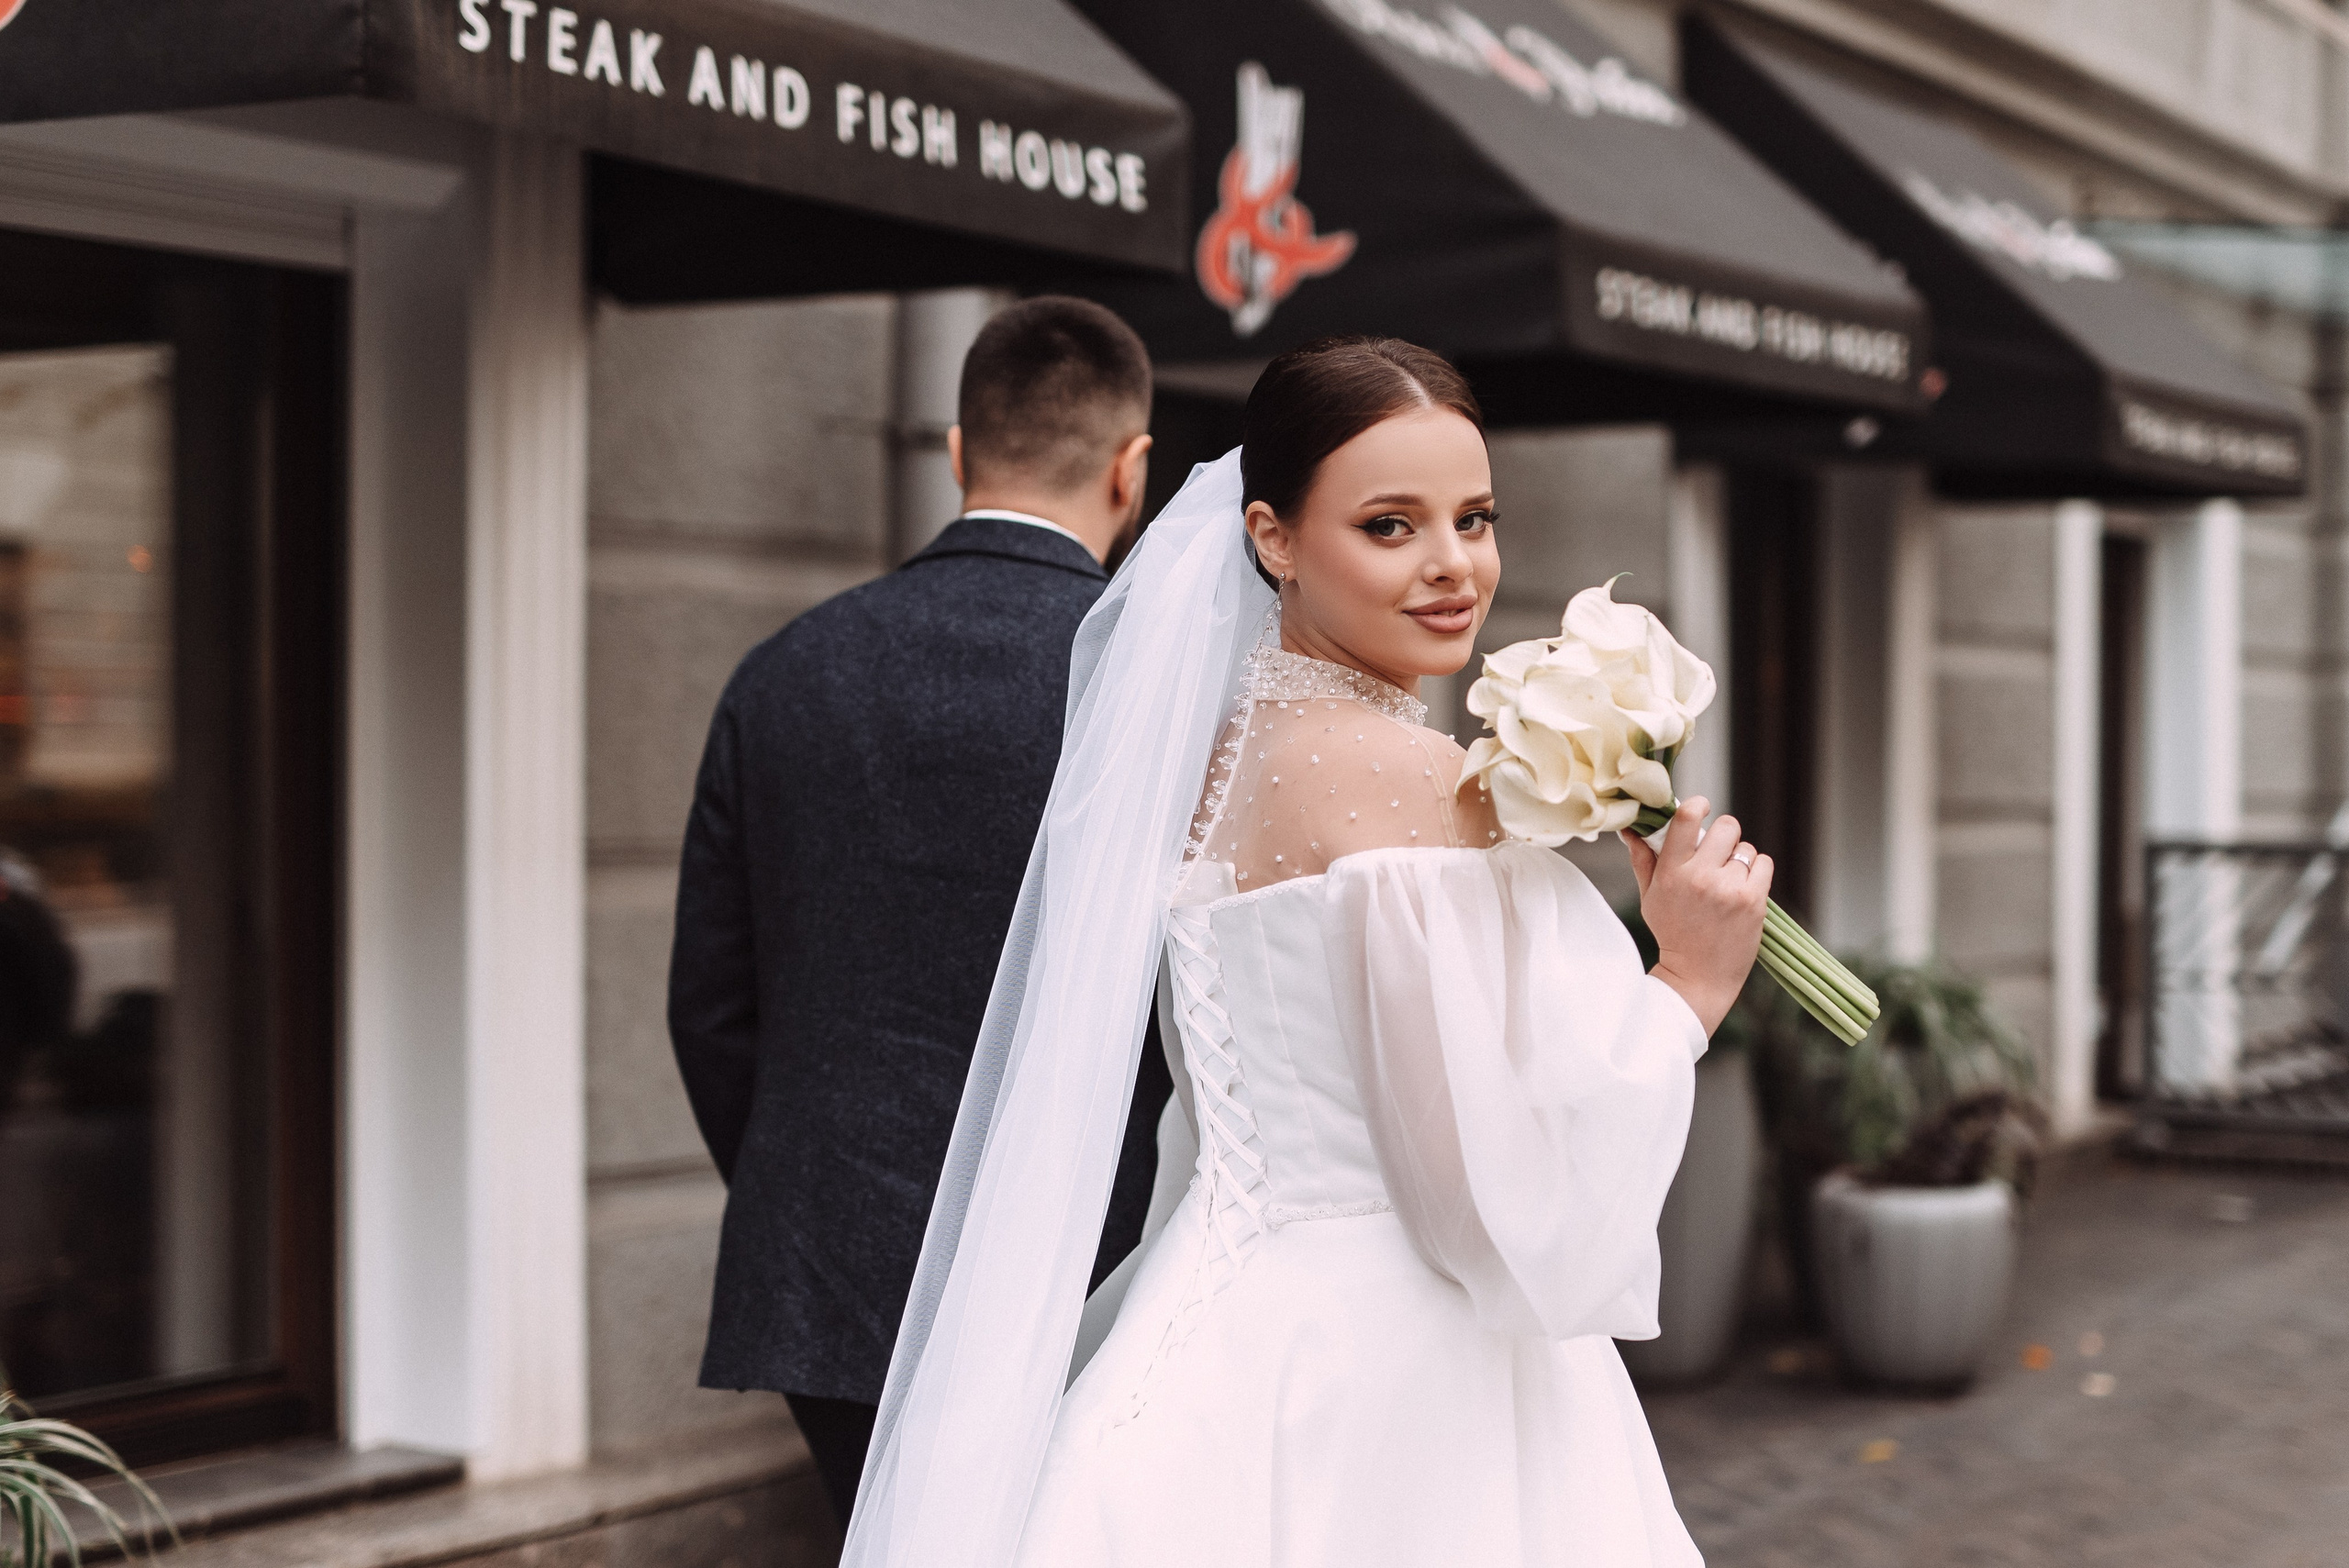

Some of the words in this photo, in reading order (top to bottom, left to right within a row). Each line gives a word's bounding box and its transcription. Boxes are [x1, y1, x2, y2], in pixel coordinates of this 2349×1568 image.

[458, 0, 665, 96] STEAK
[688, 46, 810, 129] AND
[836, 83, 957, 167] FISH
[979, 119, 1148, 213] HOUSE
[1596, 267, 1693, 334] STEAK
[1696, 292, 1758, 351] AND
